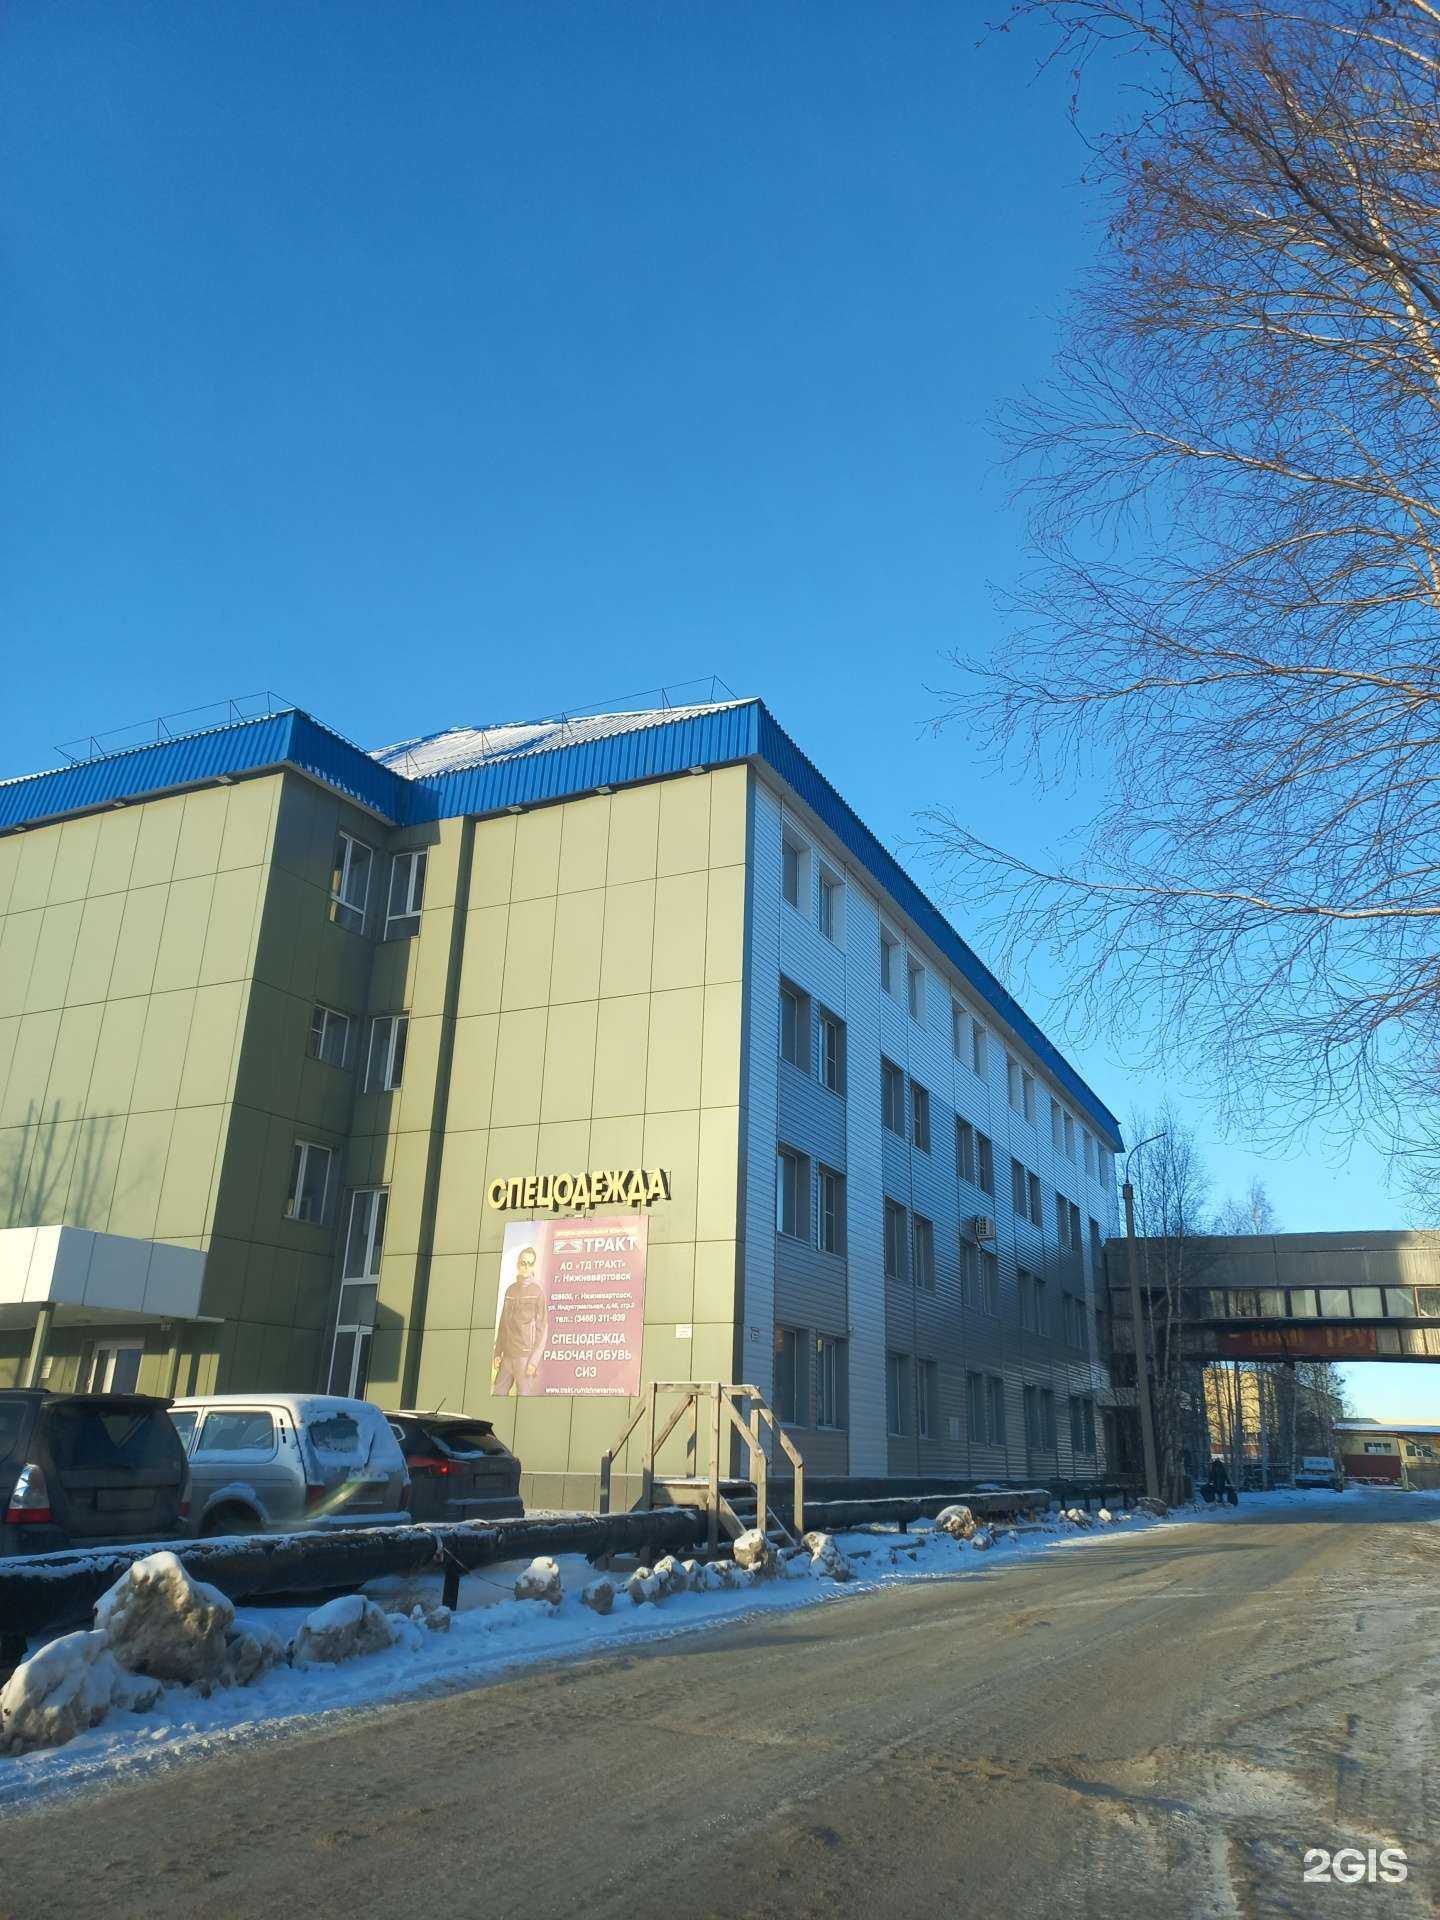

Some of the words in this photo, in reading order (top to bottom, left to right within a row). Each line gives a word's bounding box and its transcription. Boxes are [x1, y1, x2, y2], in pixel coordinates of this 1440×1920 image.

[487, 1168, 667, 1211] СПЕЦОДЕЖДА
[584, 1236, 637, 1253] ТРАКТ
[560, 1261, 573, 1271] АО
[551, 1333, 626, 1346] СПЕЦОДЕЖДА
[544, 1350, 593, 1361] РАБОЧАЯ
[595, 1349, 632, 1361] ОБУВЬ
[575, 1366, 597, 1378] СИЗ
